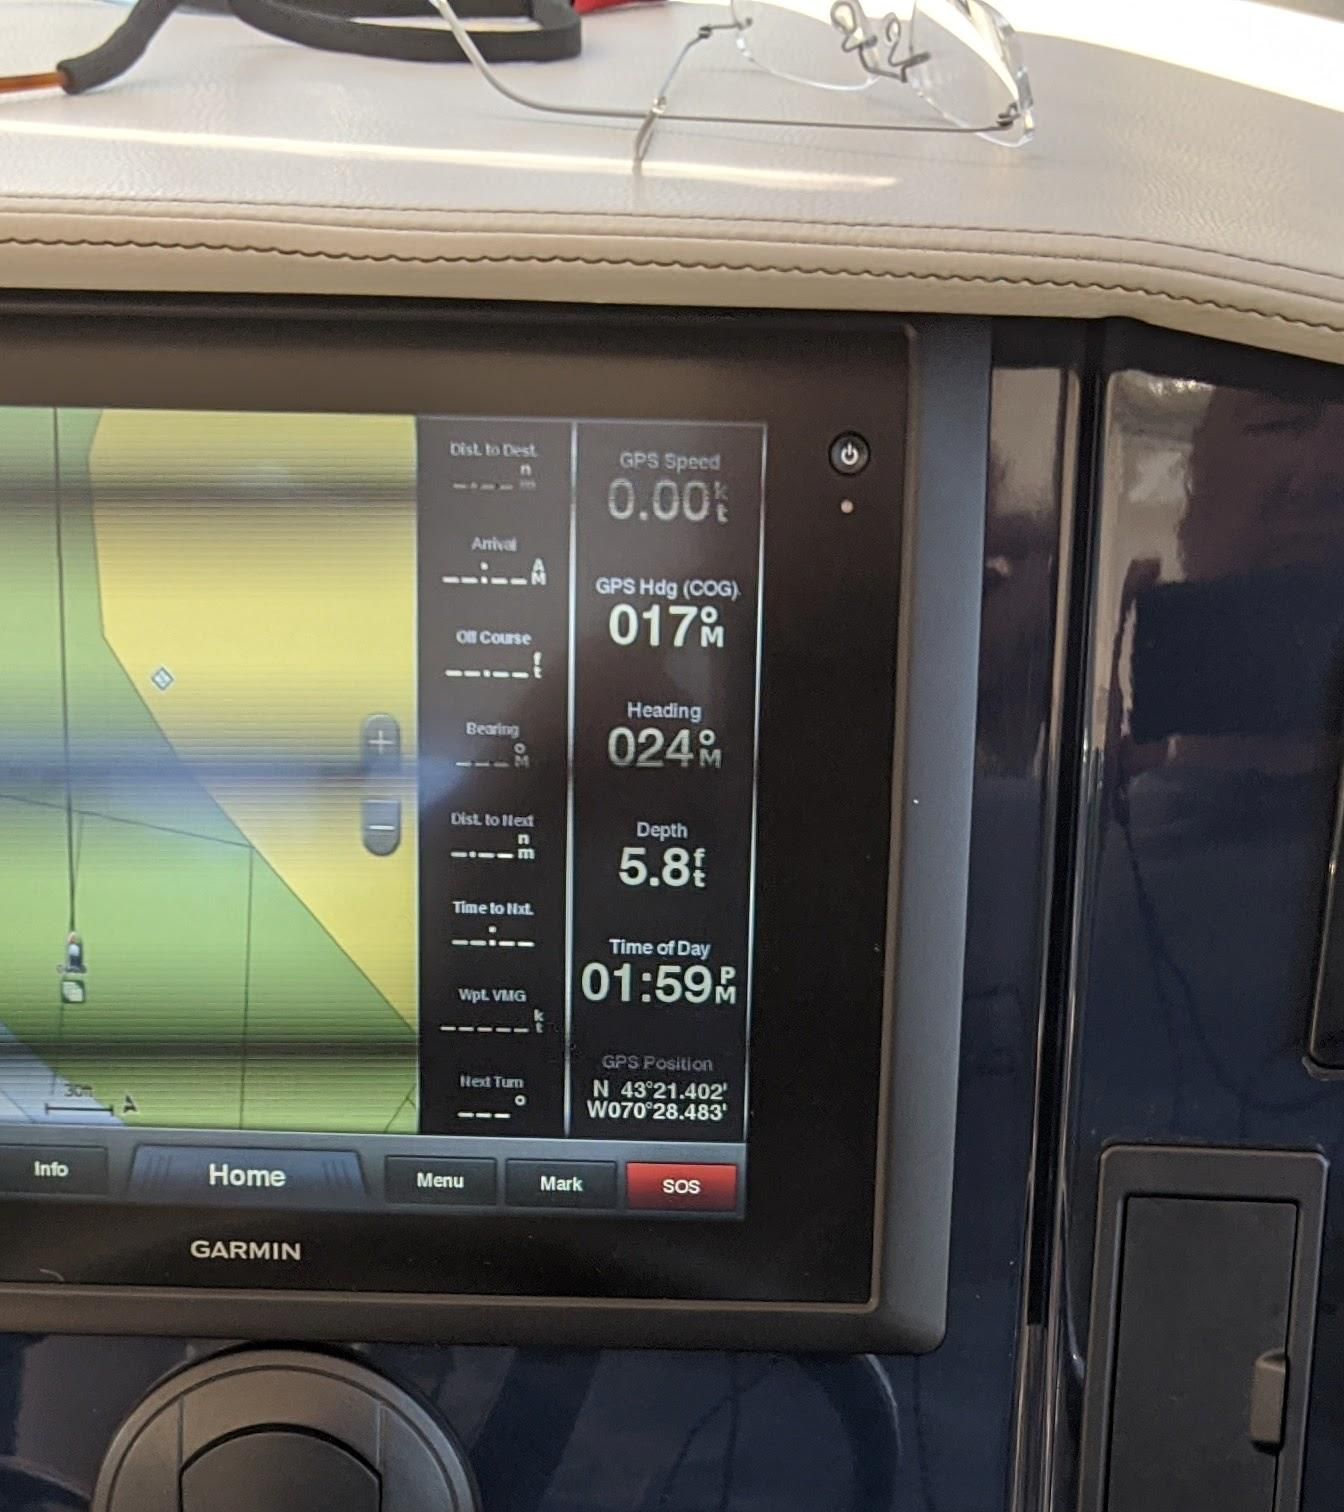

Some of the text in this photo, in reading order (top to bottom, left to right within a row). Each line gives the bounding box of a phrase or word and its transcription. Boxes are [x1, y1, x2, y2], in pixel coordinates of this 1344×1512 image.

[485, 445, 500, 456] to
[619, 453, 721, 474] GPS Speed
[471, 537, 518, 551] Arrival
[596, 578, 636, 596] GPS
[640, 579, 677, 600] Hdg
[456, 630, 532, 645] Off Course
[627, 702, 702, 722] Heading
[466, 722, 519, 739] Bearing
[485, 814, 500, 827] to
[502, 814, 535, 828] Next
[636, 822, 688, 841] Depth
[618, 846, 691, 888] 5.8
[453, 902, 487, 915] Time
[489, 903, 504, 916] to
[609, 938, 711, 960] Time of Day
[581, 962, 713, 1004] 01:59
[492, 988, 527, 1003] VMG
[602, 1055, 714, 1072] GPS Position
[460, 1075, 525, 1089] Next Turn
[593, 1080, 609, 1097] N
[34, 1161, 69, 1178] Info
[208, 1164, 287, 1188] Home
[416, 1173, 466, 1189] Menu
[540, 1176, 583, 1192] Mark
[662, 1180, 701, 1195] SOS
[190, 1240, 302, 1262] GARMIN
